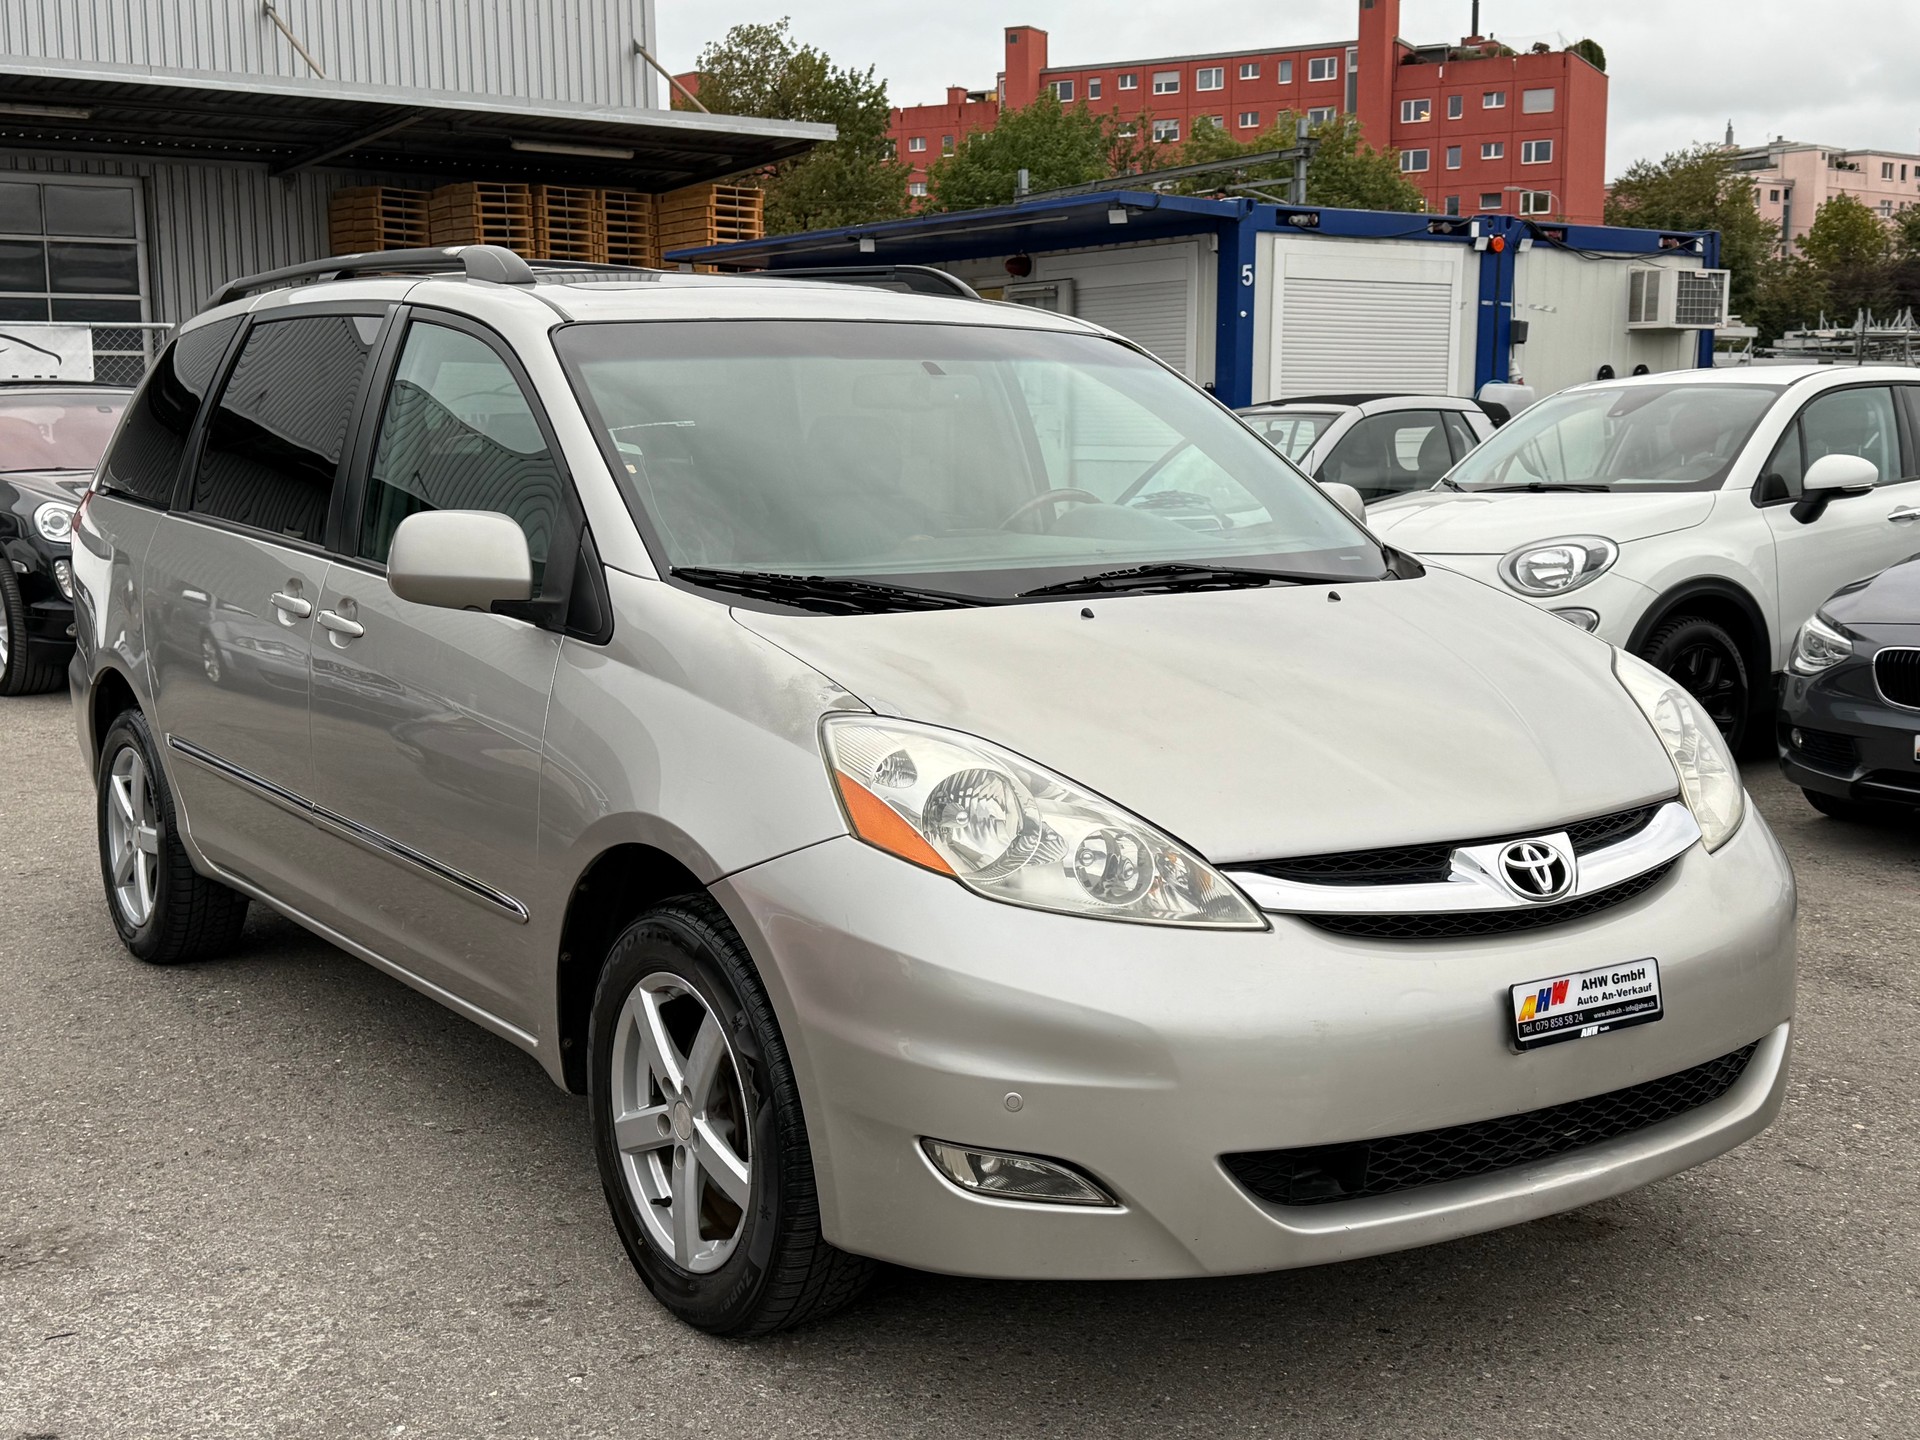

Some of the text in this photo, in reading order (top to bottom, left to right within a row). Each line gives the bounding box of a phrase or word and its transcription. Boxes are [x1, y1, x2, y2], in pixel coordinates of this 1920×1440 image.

[1242, 264, 1253, 286] 5
[1581, 968, 1646, 991] AHW GmbH
[1518, 979, 1570, 1021] AHW
[1577, 983, 1652, 1006] Auto An-Verkauf
[1522, 1012, 1584, 1033] Tel. 079 858 58 24
[1580, 1025, 1599, 1037] AHW
